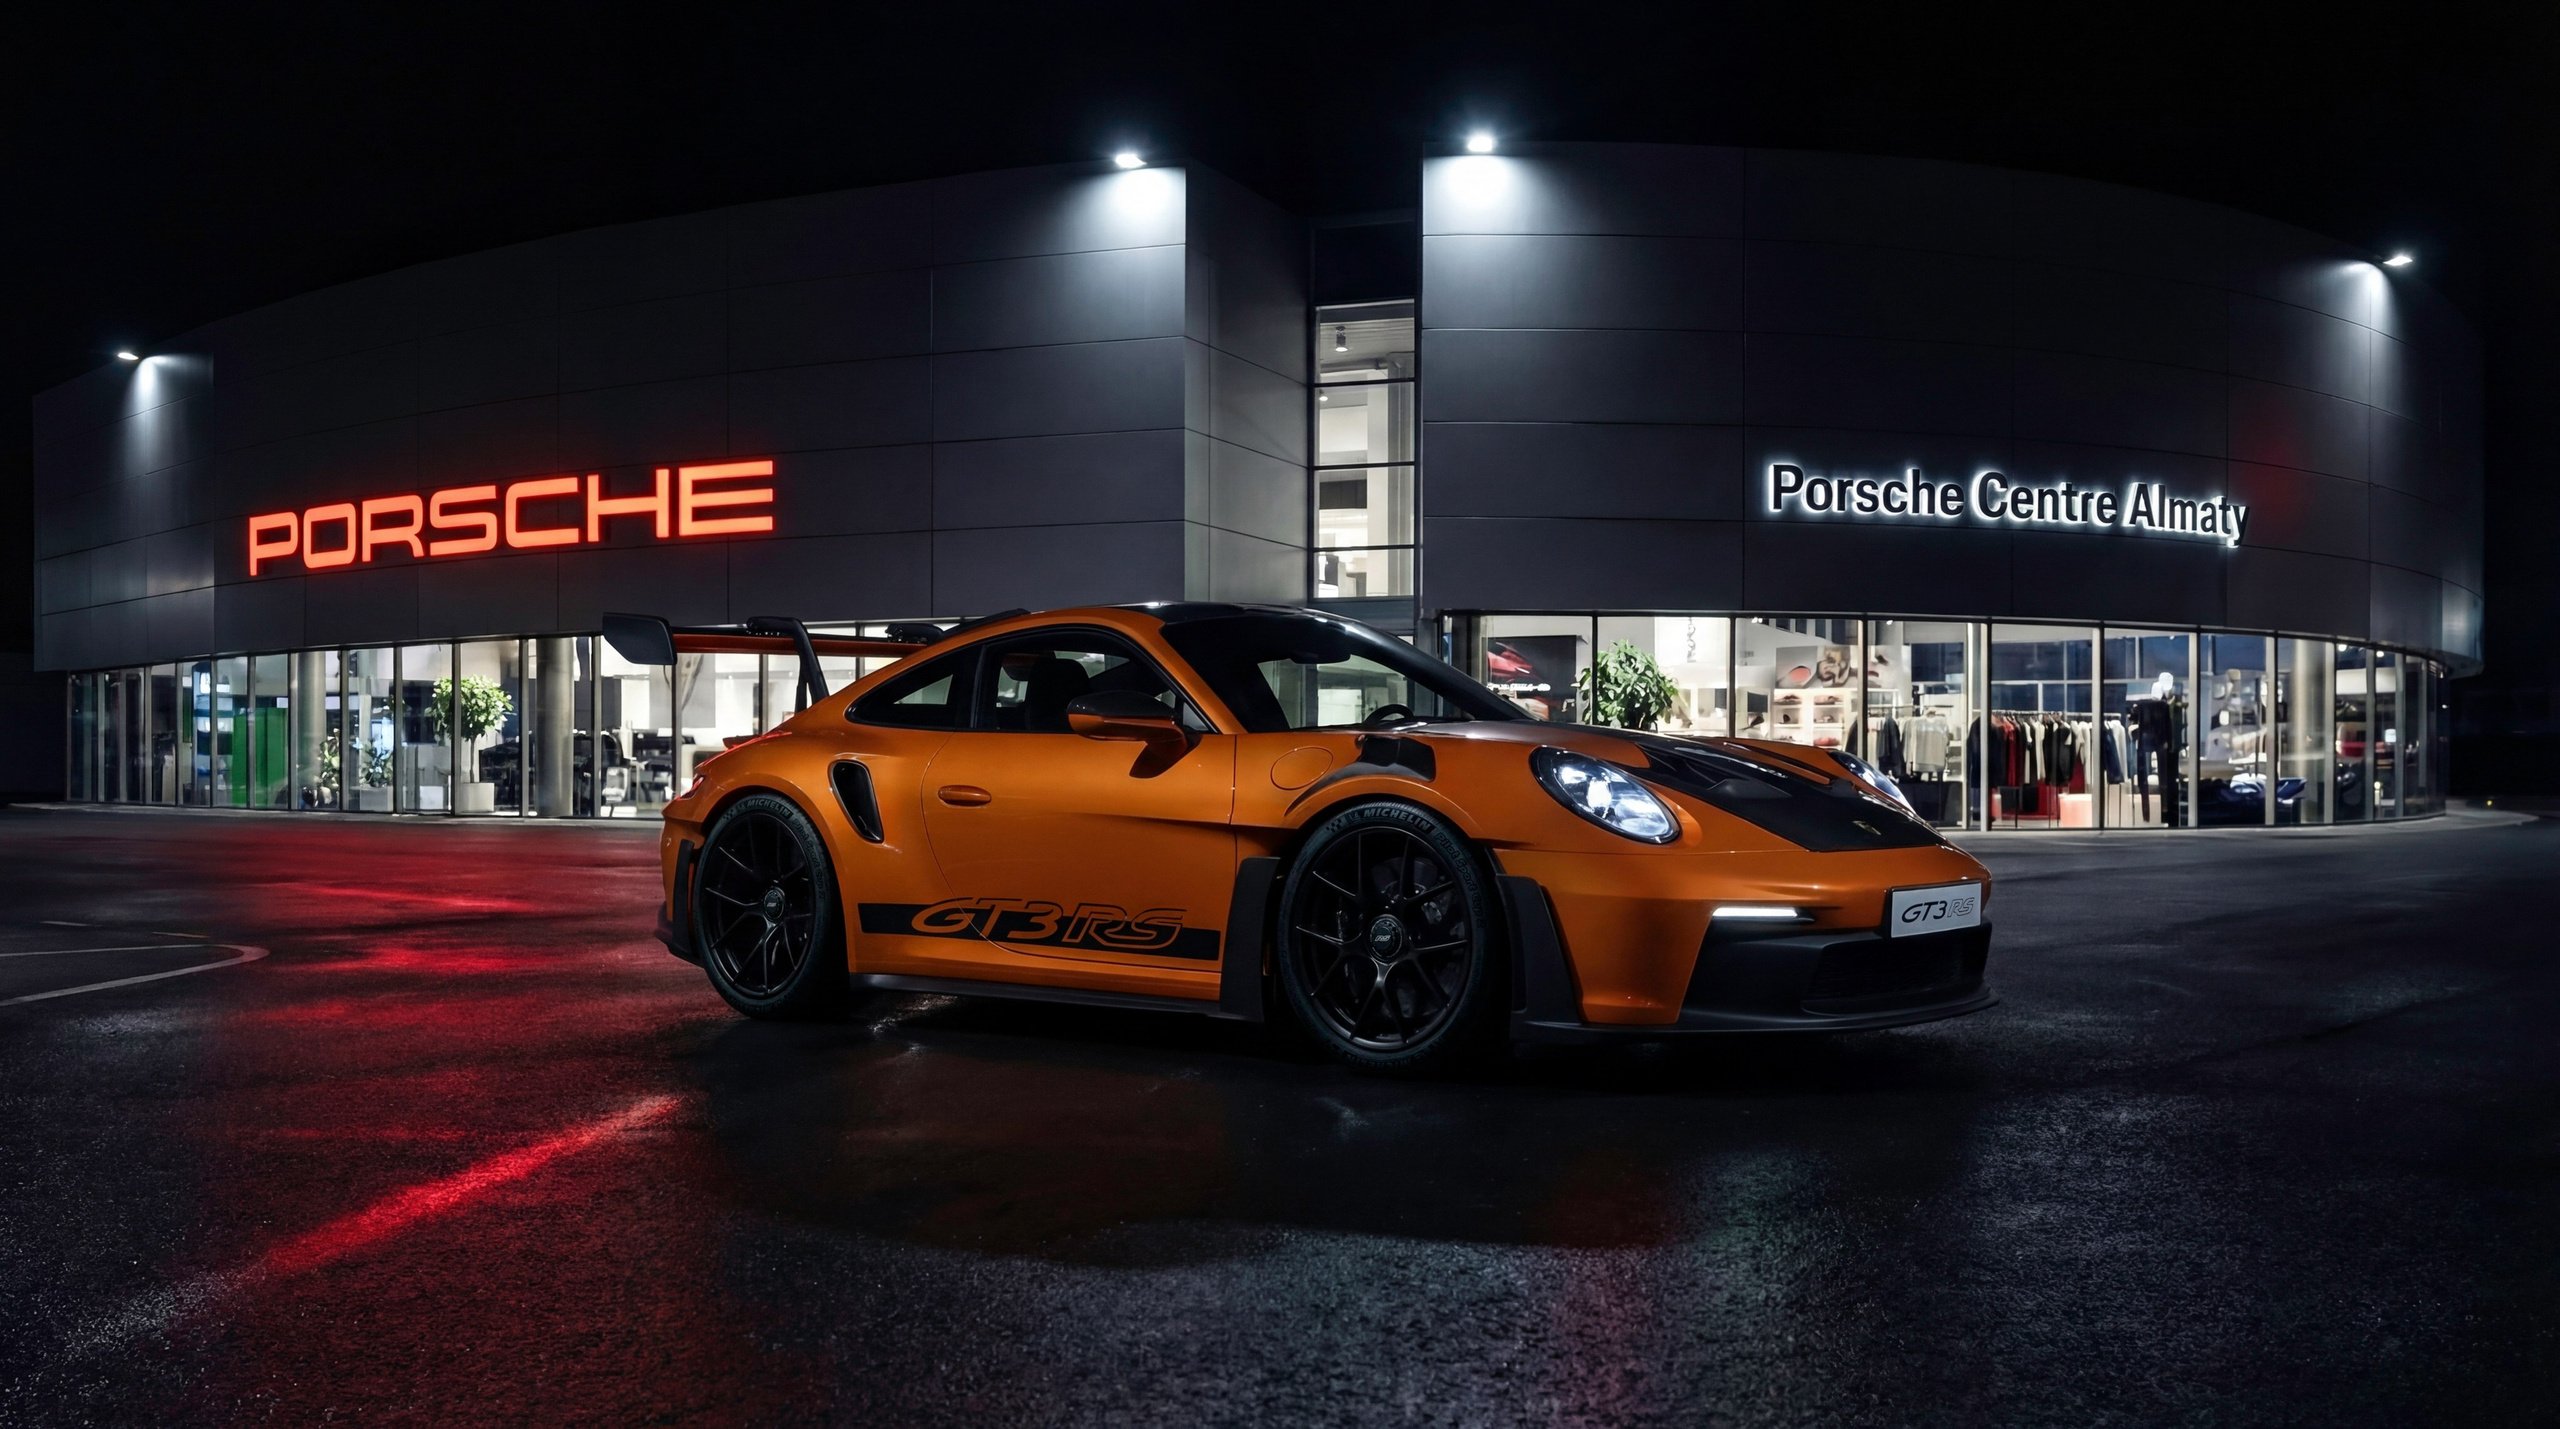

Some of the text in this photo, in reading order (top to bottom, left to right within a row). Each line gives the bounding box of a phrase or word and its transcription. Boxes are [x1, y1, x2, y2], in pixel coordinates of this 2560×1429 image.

[249, 460, 773, 576] PORSCHE
[1770, 464, 2250, 546] Porsche Centre Almaty
[747, 798, 791, 819] MICHELIN
[1363, 807, 1433, 833] MICHELIN
[1433, 832, 1461, 860] Pilot
[1455, 859, 1478, 891] Sport
[1471, 892, 1484, 917] Cup
